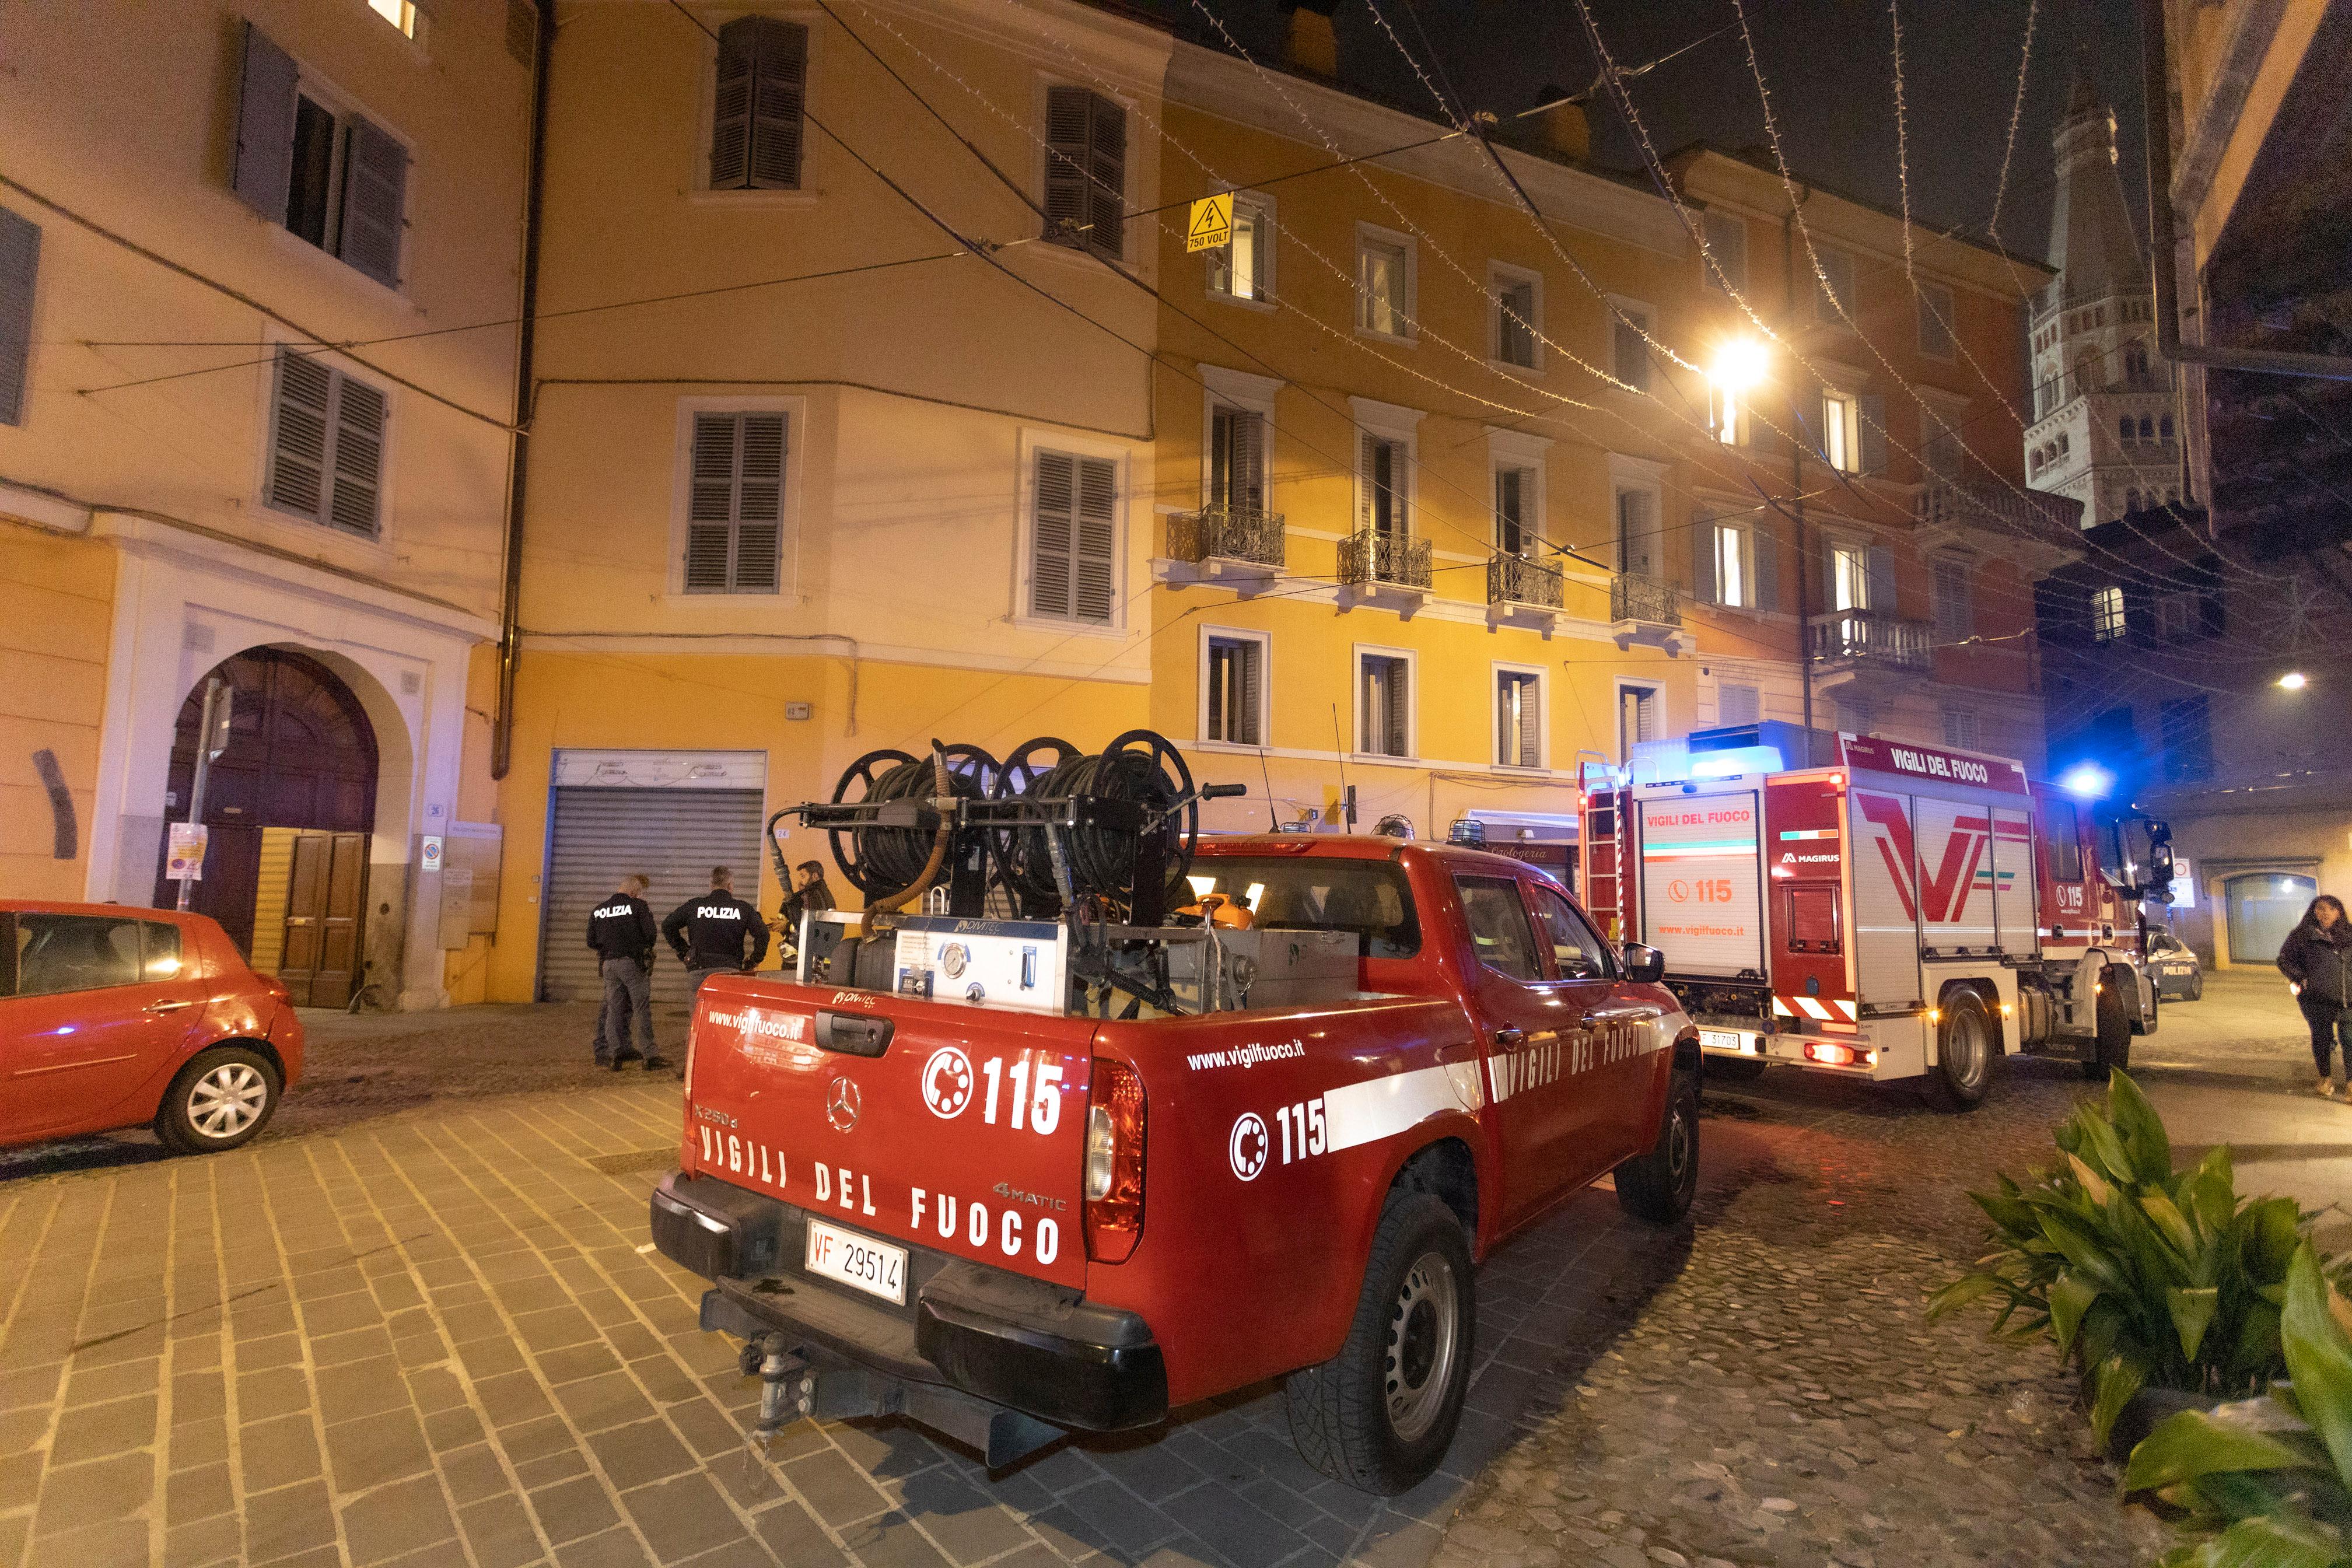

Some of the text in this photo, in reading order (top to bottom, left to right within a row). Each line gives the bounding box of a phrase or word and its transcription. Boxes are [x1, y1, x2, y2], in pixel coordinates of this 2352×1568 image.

[1189, 232, 1228, 249] 750 VOLT
[1891, 748, 1988, 783] VIGILI DEL FUOCO
[1647, 810, 1749, 827] VIGILI DEL FUOCO
[1491, 846, 1546, 859] Orologeria
[1696, 880, 1732, 902] 115
[2067, 886, 2082, 907] 115
[594, 905, 632, 920] POLIZIA
[697, 907, 741, 920] POLIZIA
[967, 921, 1004, 932] DIVITEC
[1658, 924, 1744, 936] www.vigilfuoco.it
[2163, 966, 2192, 975] POLIZIA
[1712, 1034, 1736, 1046] 31703
[1187, 1039, 1306, 1070] www.vigilfuoco.it
[1510, 1025, 1639, 1096] VIGILI DEL FUOCO
[984, 1057, 1063, 1135] 115
[1276, 1098, 1326, 1165] 115
[701, 1125, 1058, 1265] VIGILI DEL FUOCO
[993, 1182, 1066, 1211] 4MATIC
[814, 1231, 897, 1289] VF 29514
